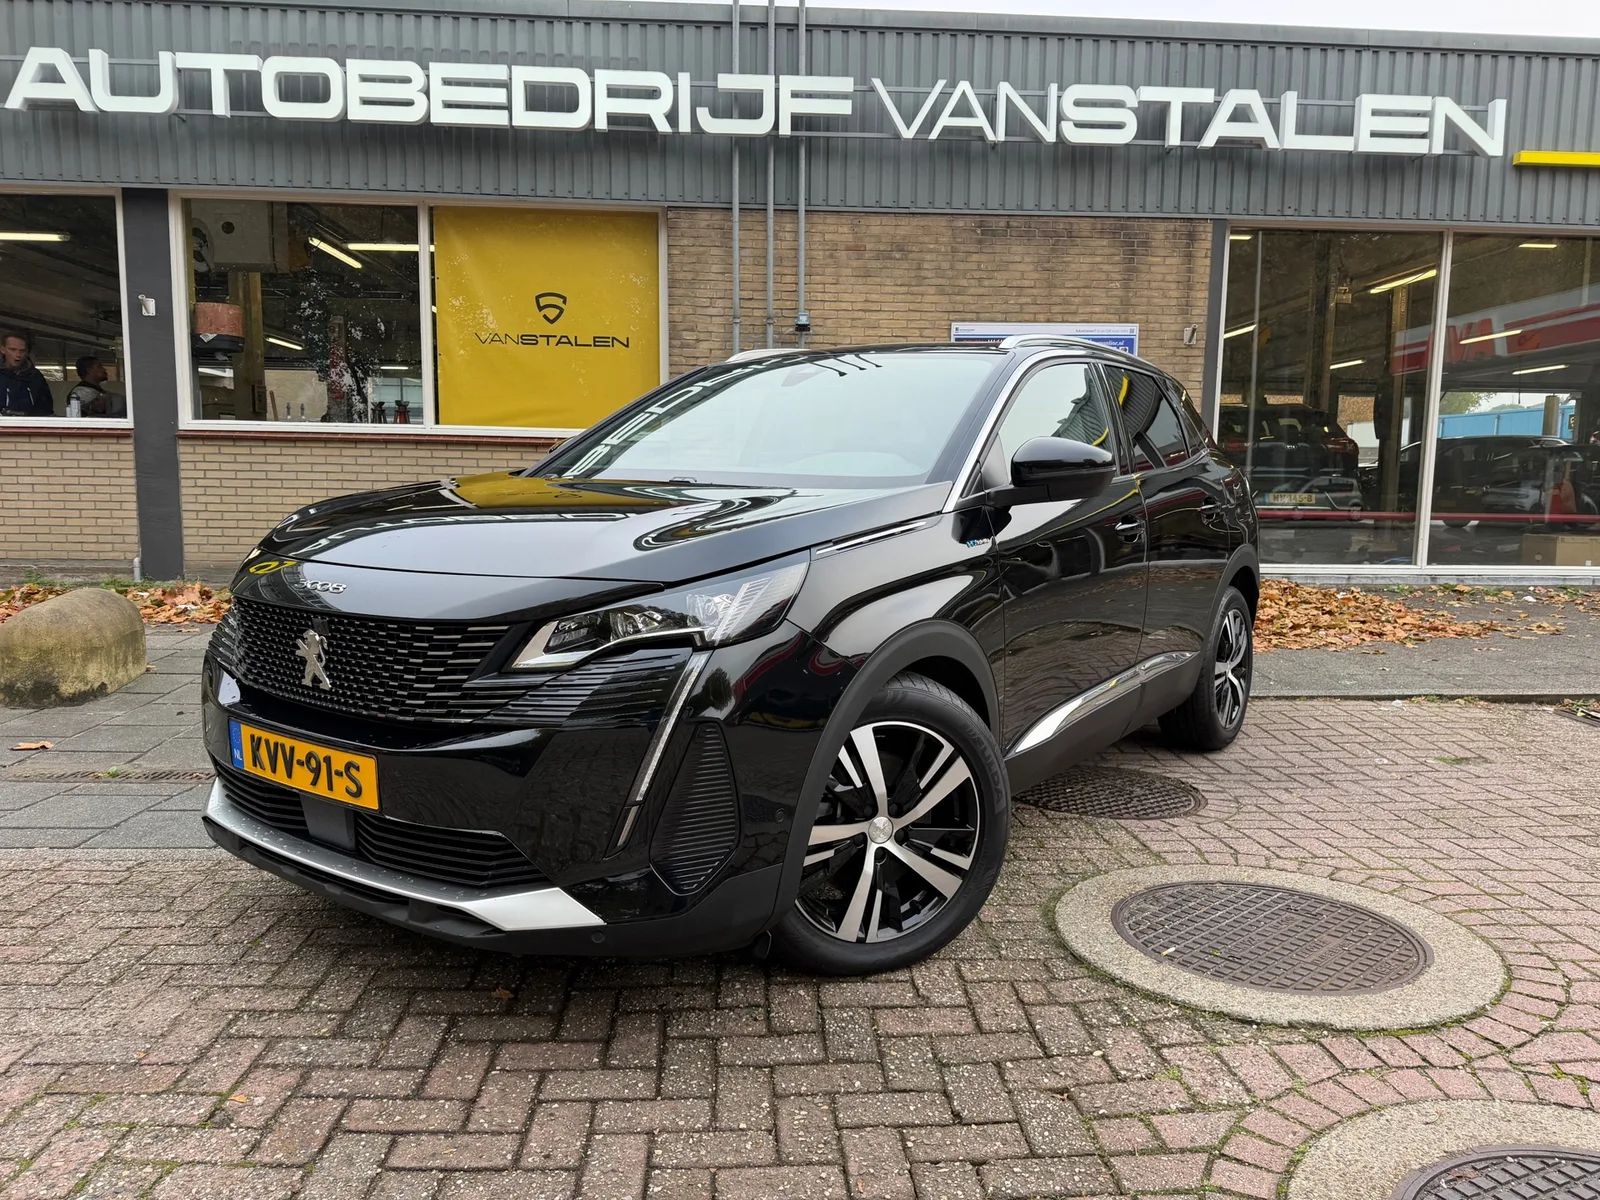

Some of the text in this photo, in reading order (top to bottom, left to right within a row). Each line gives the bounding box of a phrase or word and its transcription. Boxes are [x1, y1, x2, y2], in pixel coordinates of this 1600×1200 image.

[6, 46, 1508, 157] AUTOBEDRIJF VANSTALEN
[474, 332, 630, 349] VANSTALEN
[250, 733, 362, 799] KVV-91-S
